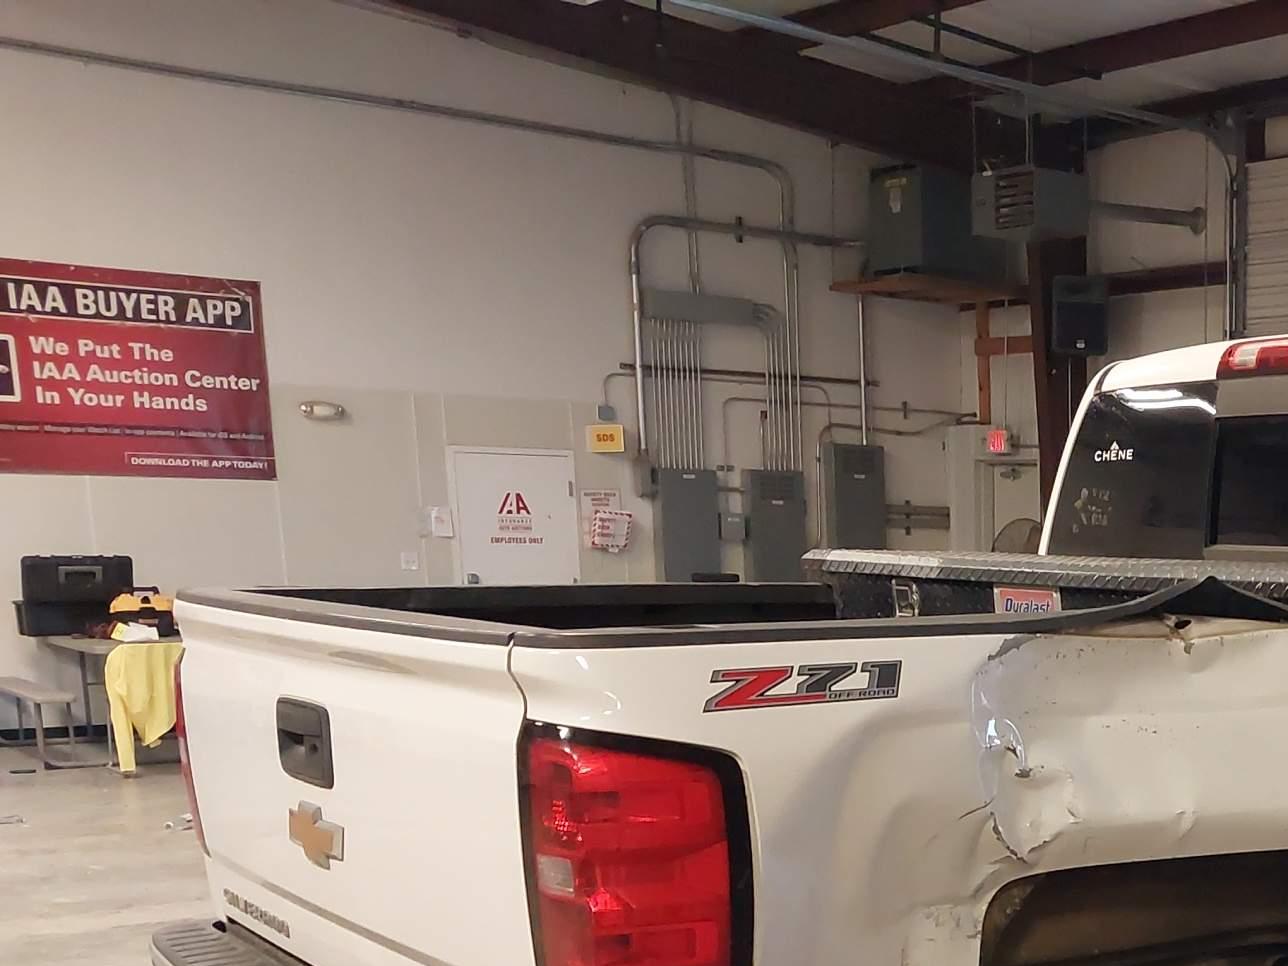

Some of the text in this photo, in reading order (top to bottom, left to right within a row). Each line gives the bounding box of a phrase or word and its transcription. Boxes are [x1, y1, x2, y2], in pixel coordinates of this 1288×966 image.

[7, 282, 242, 326] IAA BUYER APP
[28, 336, 174, 362] We Put The
[33, 361, 261, 391] IAA Auction Center
[36, 386, 208, 412] In Your Hands
[596, 433, 615, 442] SDS
[131, 457, 190, 467] DOWNLOAD
[191, 459, 209, 468] THE
[211, 460, 231, 469] APP
[1004, 598, 1050, 613] Duralast
[703, 660, 902, 712] Z71
[857, 688, 895, 698] ROAD
